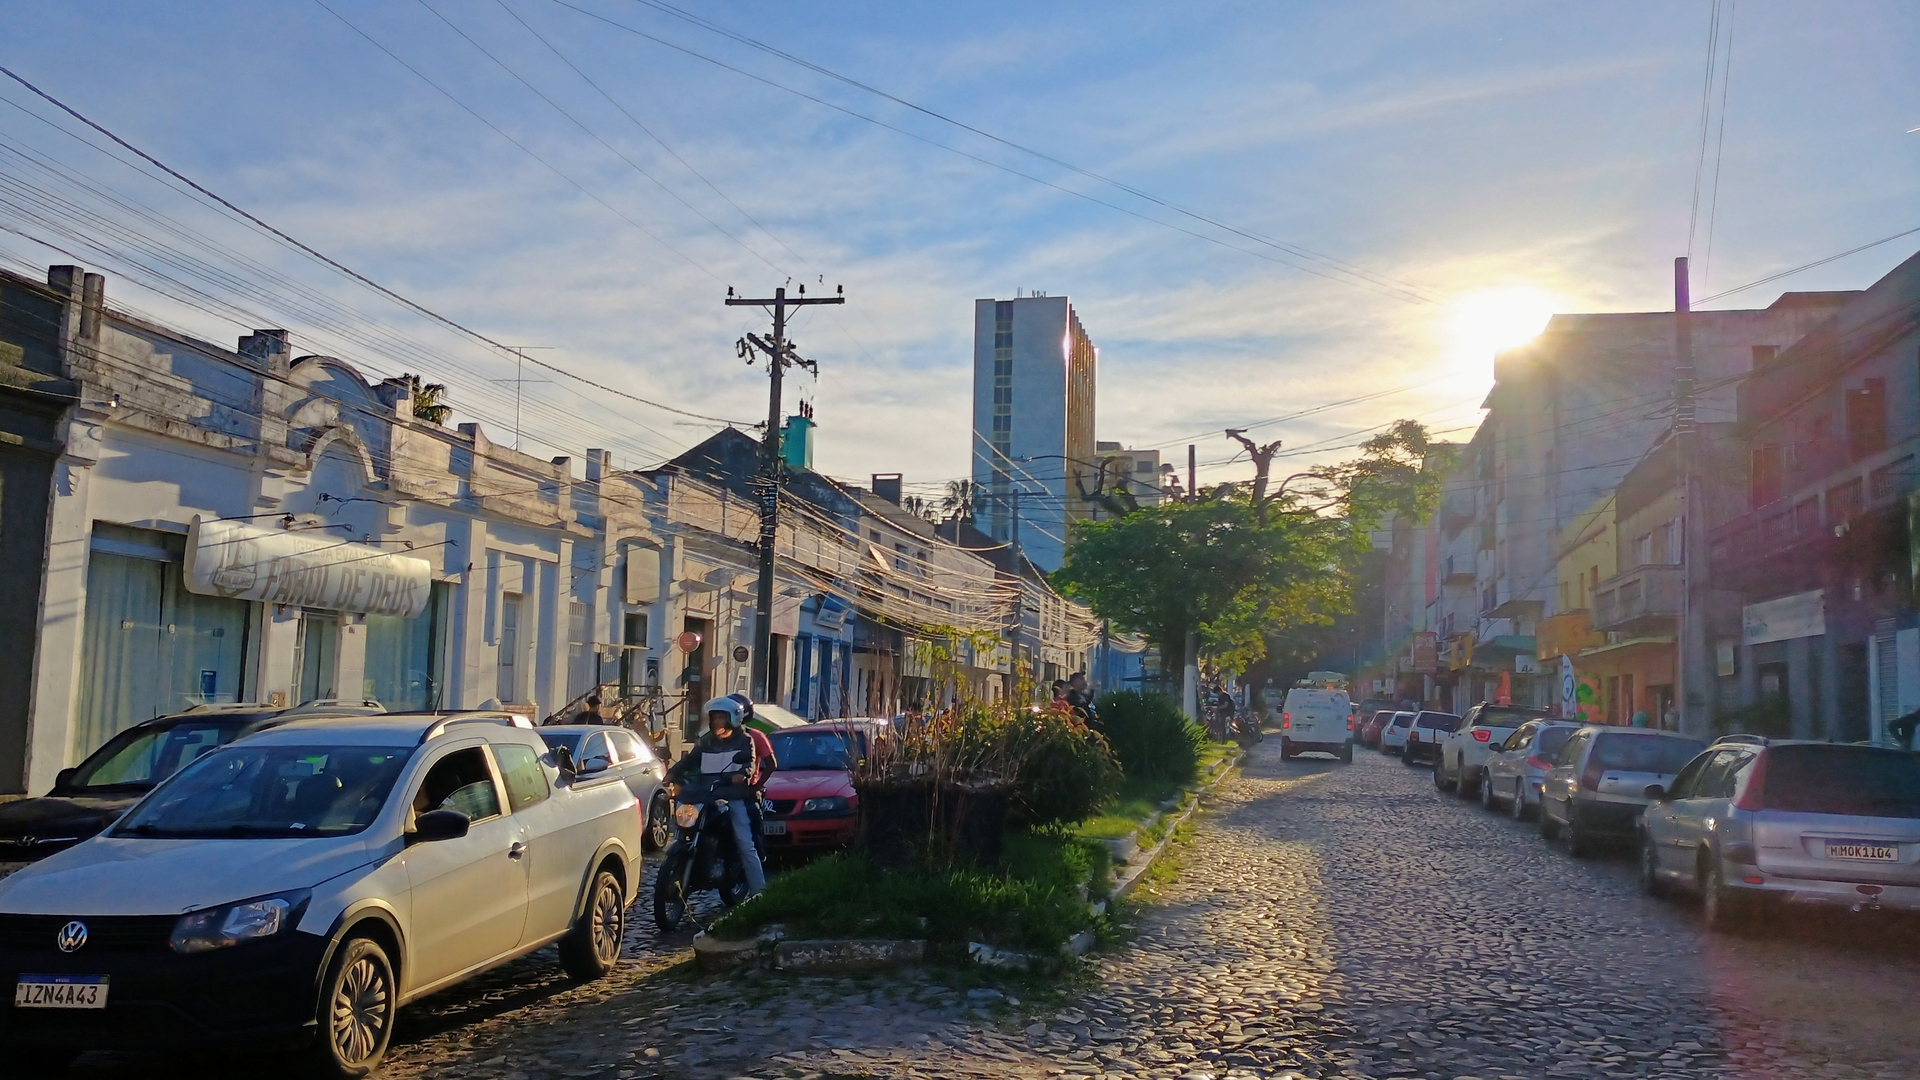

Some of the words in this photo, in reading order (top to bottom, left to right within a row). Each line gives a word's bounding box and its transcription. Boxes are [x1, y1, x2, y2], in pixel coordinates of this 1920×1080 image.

[293, 539, 333, 560] IGREJA
[260, 554, 330, 606] FAROL
[332, 567, 367, 611] DE
[364, 571, 418, 616] DEUS
[58, 921, 88, 952] VW
[22, 985, 98, 1005] IZN4A43
